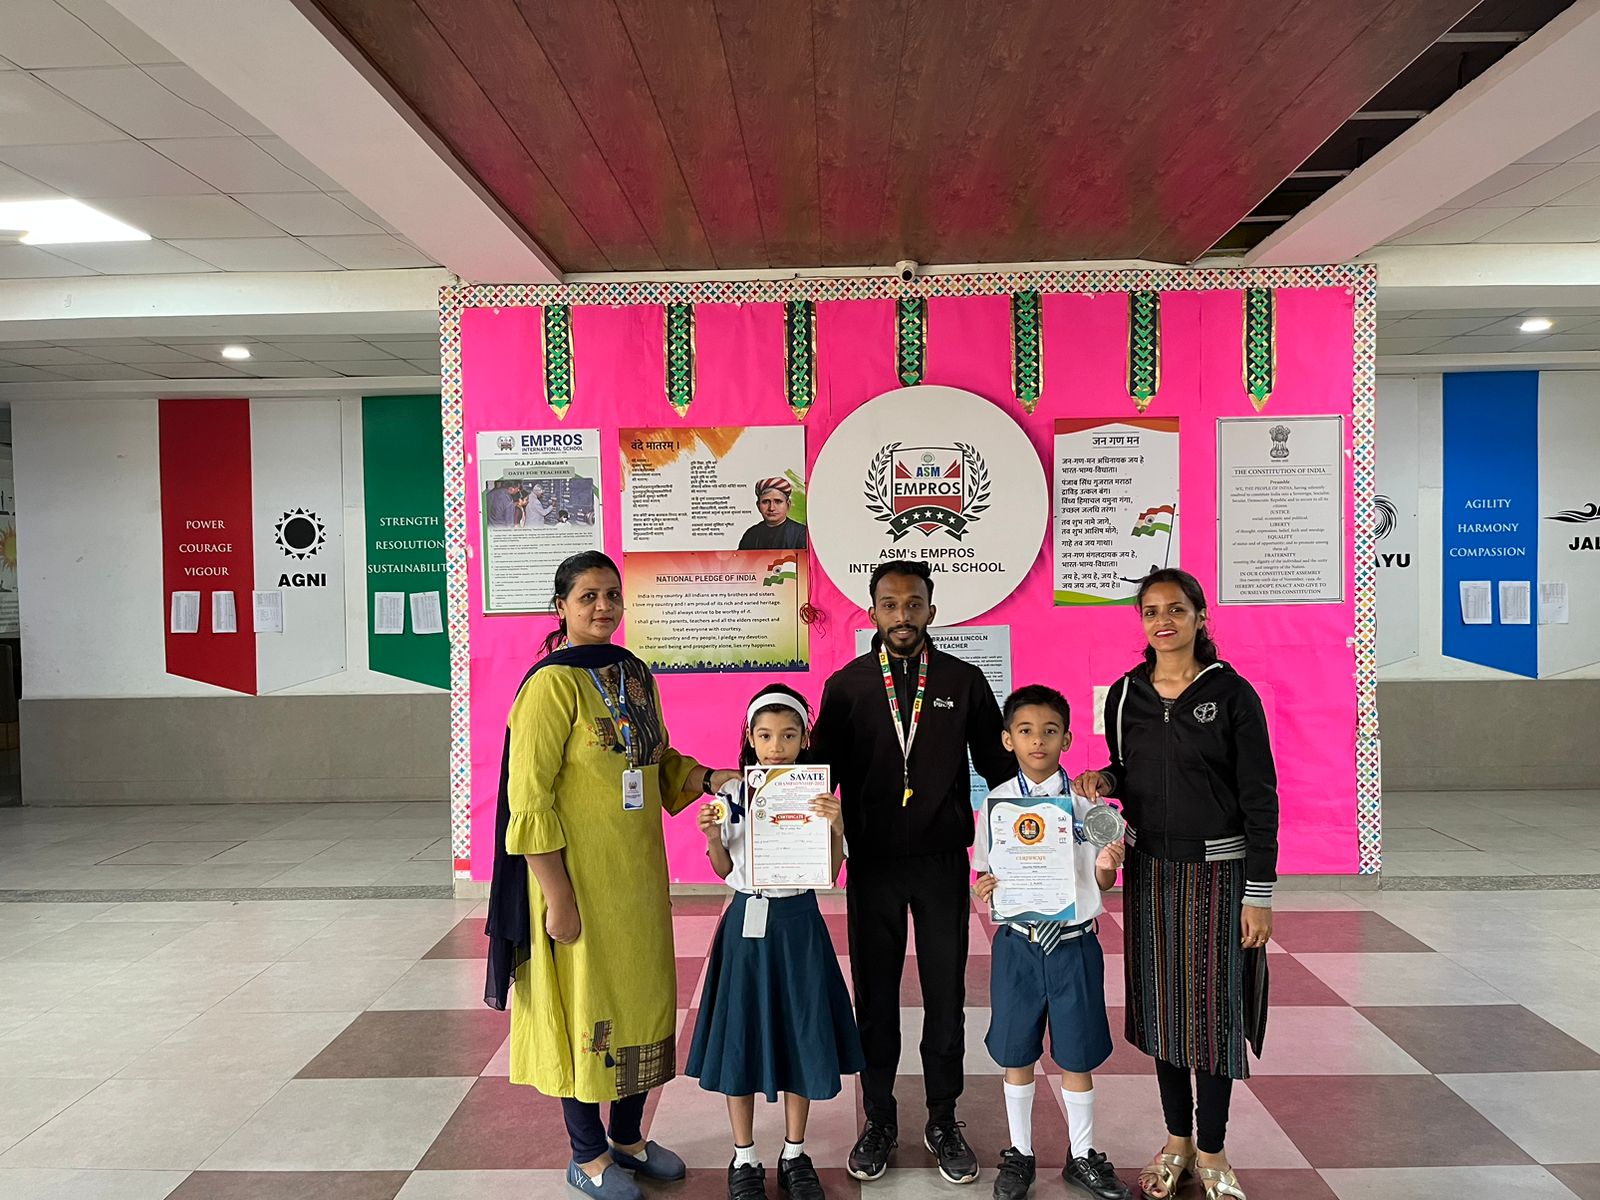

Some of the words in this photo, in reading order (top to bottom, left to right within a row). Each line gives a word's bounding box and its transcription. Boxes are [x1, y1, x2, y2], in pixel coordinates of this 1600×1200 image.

[522, 434, 582, 446] EMPROS
[1093, 436, 1106, 445] जन
[1109, 436, 1124, 444] गण
[1126, 436, 1139, 444] मन
[631, 439, 644, 450] वंदे
[646, 441, 674, 452] मातरम्
[1140, 454, 1144, 464] हे
[916, 467, 940, 477] ASM
[895, 482, 960, 495] EMPROS
[1465, 499, 1511, 509] AGILITY
[186, 520, 226, 529] POWER
[380, 516, 439, 526] STRENGTH
[1071, 528, 1082, 536] शुभ
[1458, 523, 1519, 533] HARMONY
[179, 543, 232, 553] COURAGE
[376, 540, 445, 550] RESOLUTION
[879, 549, 917, 558] ASM's
[920, 548, 975, 558] EMPROS
[1450, 547, 1526, 557] COMPASSION
[184, 567, 229, 576] VIGOUR
[368, 564, 447, 574] SUSTAINABILIT
[952, 562, 1005, 572] SCHOOL
[278, 573, 326, 587] AGNI
[694, 574, 723, 582] PLEDGE
